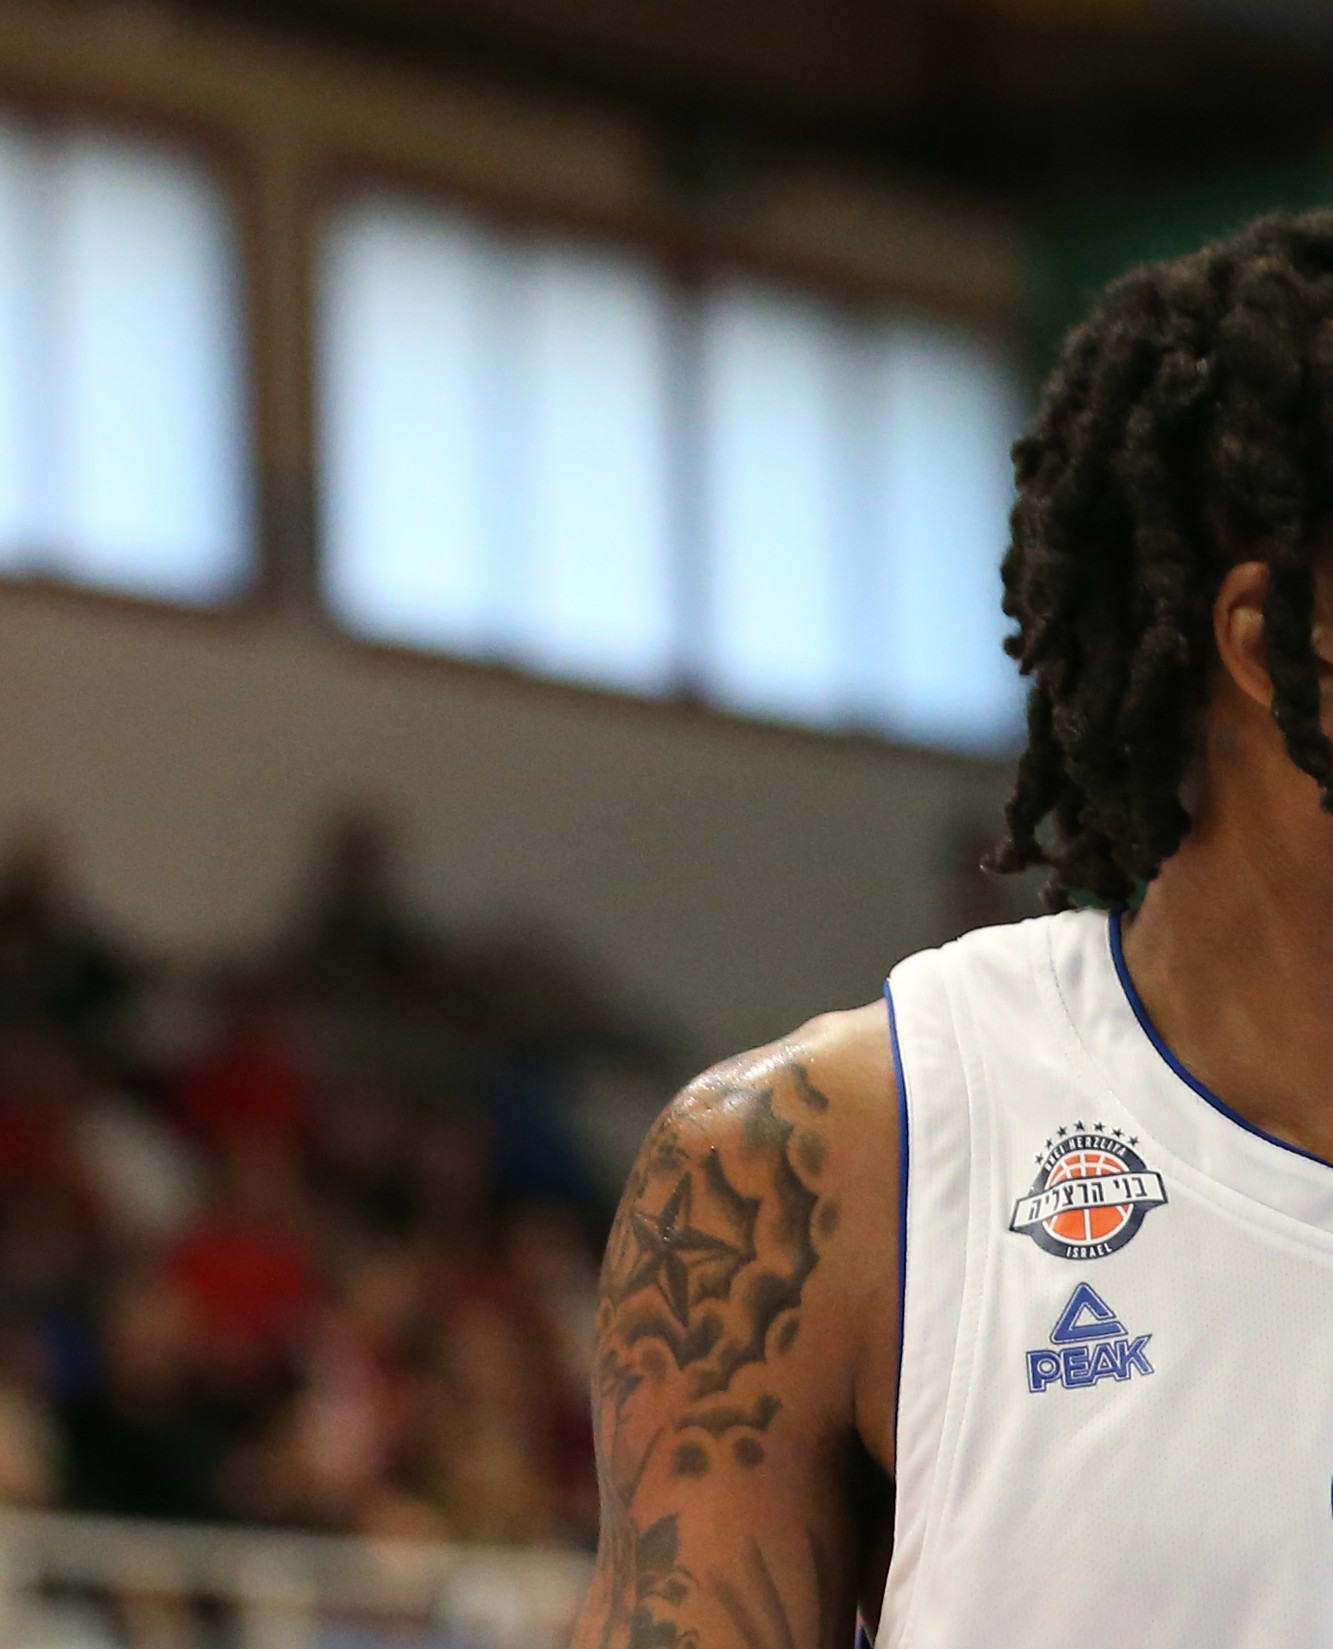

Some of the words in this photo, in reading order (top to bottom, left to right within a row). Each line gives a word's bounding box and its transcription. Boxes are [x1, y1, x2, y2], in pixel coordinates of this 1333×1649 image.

[1068, 1136, 1127, 1157] HERZLIYA
[1113, 1176, 1149, 1199] בני
[1028, 1181, 1105, 1221] הרצליה
[1066, 1242, 1113, 1258] ISRAEL
[1026, 1334, 1154, 1393] PEAK
